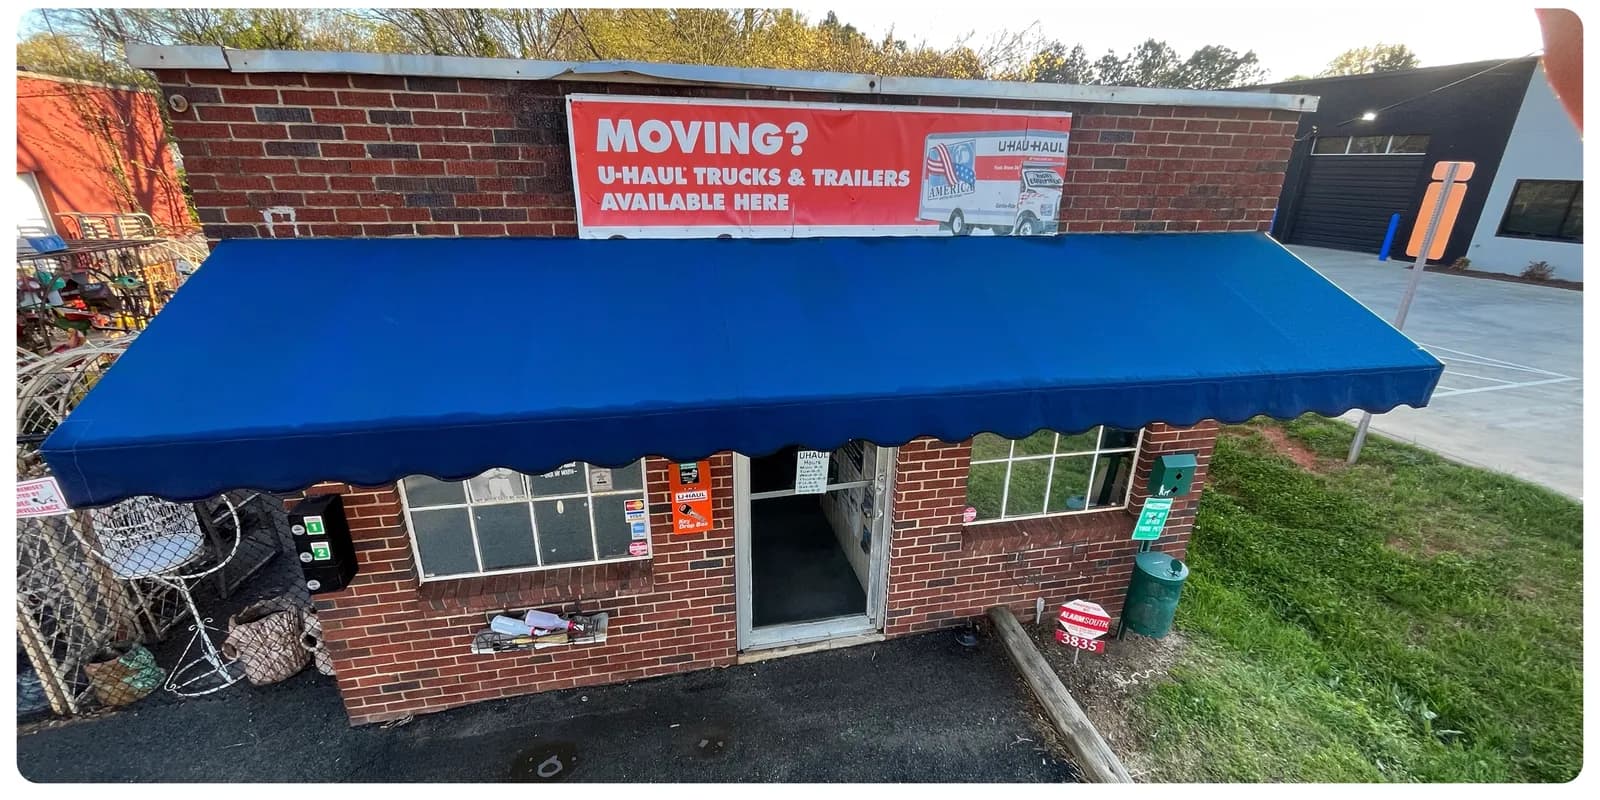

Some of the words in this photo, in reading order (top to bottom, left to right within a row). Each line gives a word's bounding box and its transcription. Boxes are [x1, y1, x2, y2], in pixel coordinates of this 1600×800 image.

[596, 118, 808, 156] MOVING?
[693, 167, 781, 186] TRUCKS
[787, 167, 806, 187] &
[812, 169, 910, 187] TRAILERS
[929, 183, 975, 198] AMERICA
[600, 193, 726, 212] AVAILABLE
[733, 193, 789, 211] HERE
[1061, 634, 1097, 651] 3835
